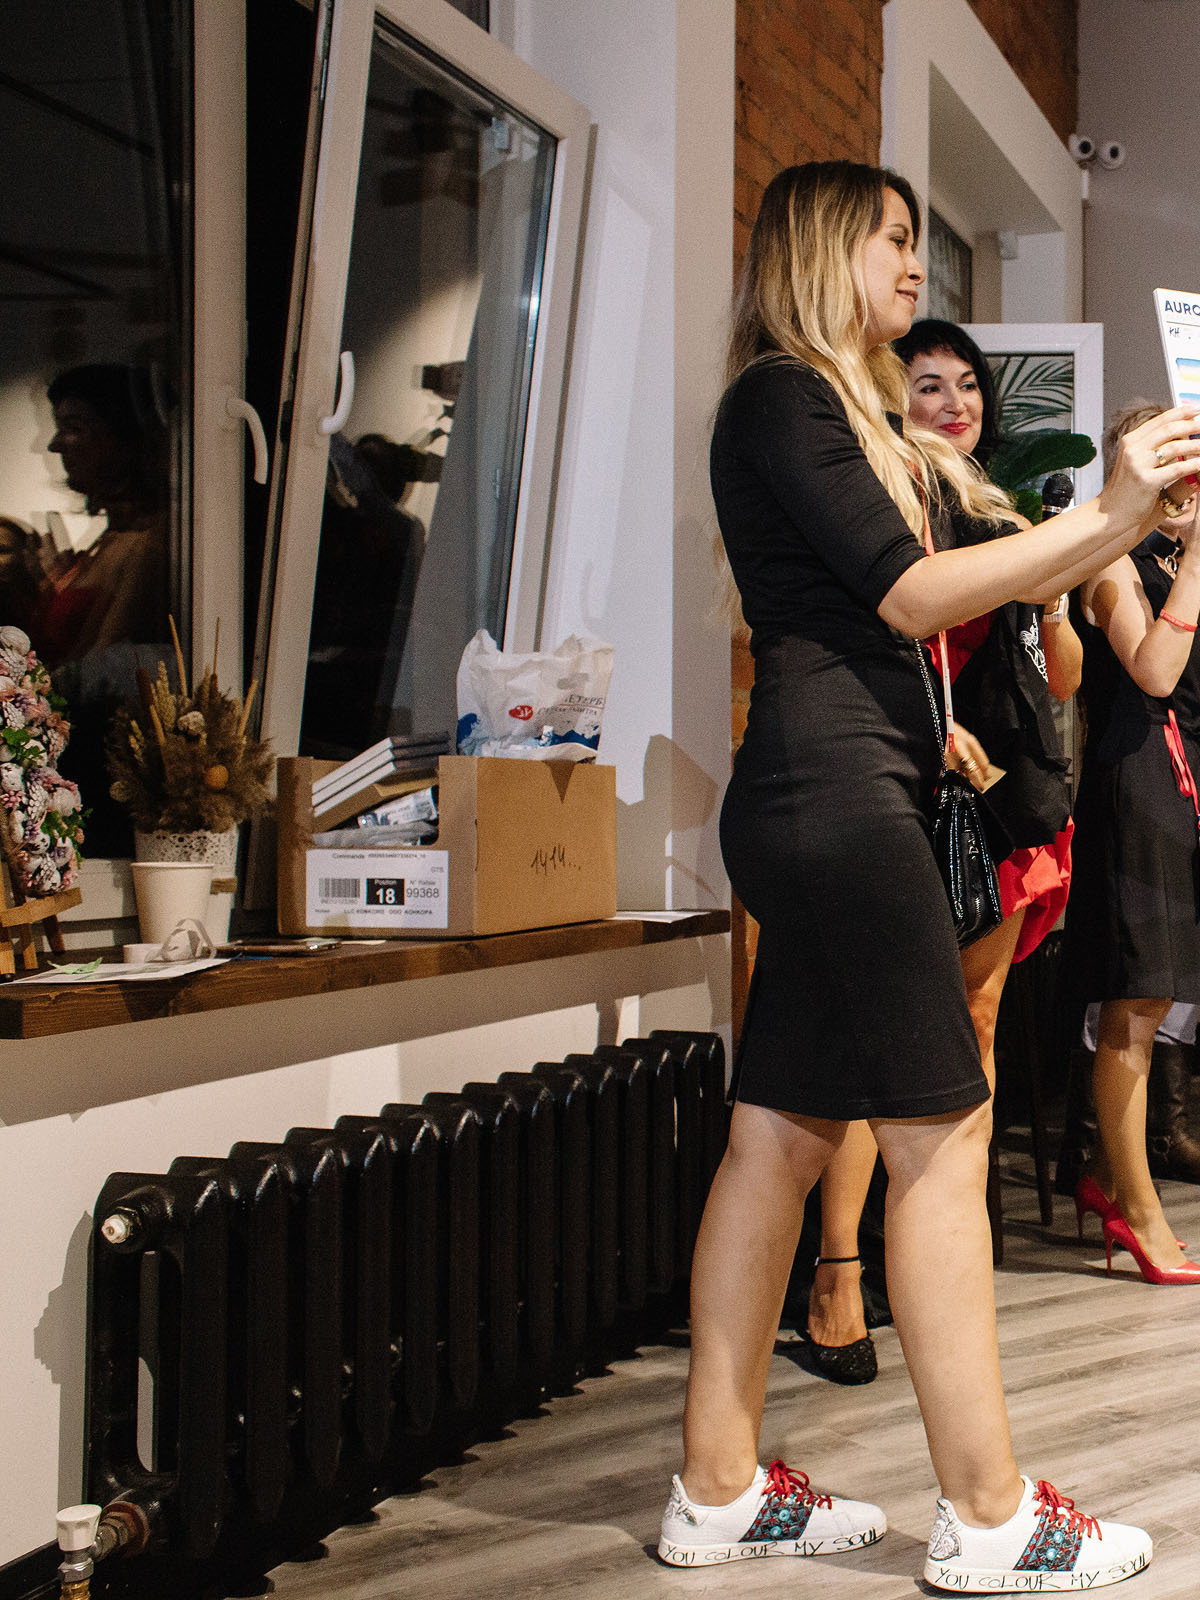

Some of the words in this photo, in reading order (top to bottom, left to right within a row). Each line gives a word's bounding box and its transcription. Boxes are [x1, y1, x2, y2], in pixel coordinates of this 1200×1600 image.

[376, 888, 396, 904] 18
[406, 888, 440, 899] 99368
[665, 1544, 695, 1564] YOU
[794, 1539, 824, 1556] MY
[833, 1527, 885, 1551] SOUL
[934, 1567, 970, 1590] YOU
[1071, 1570, 1101, 1589] MY
